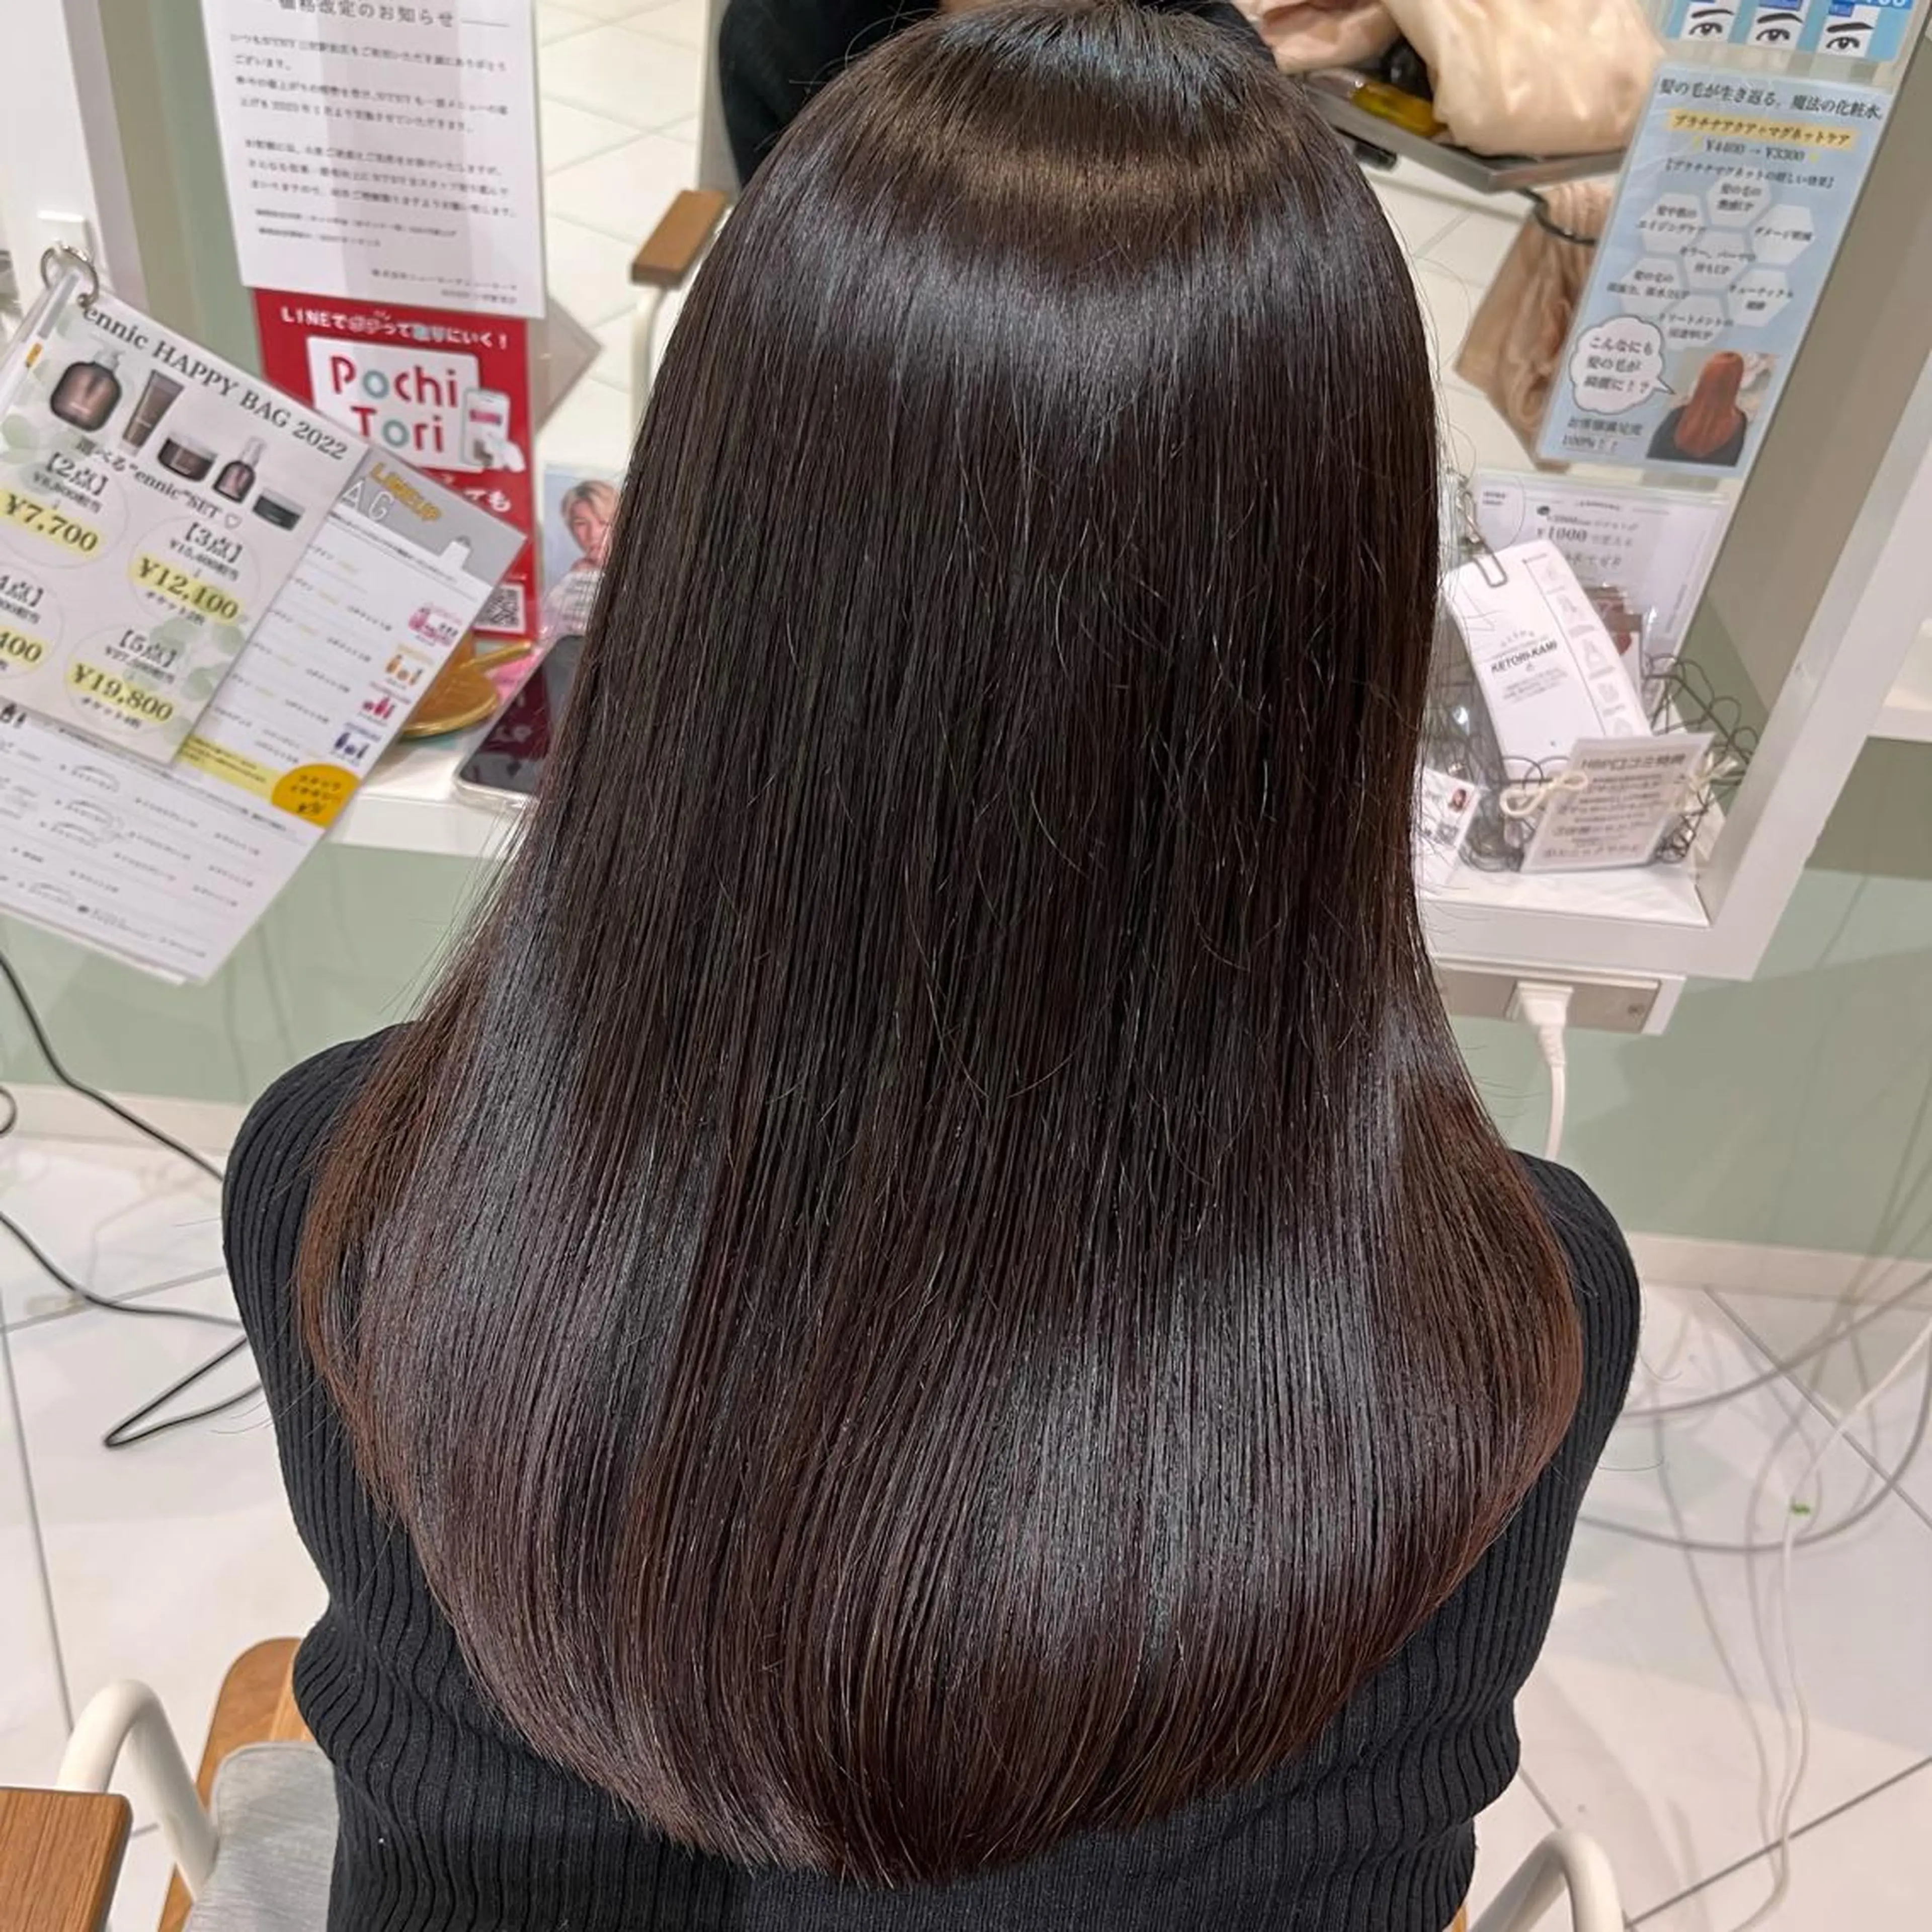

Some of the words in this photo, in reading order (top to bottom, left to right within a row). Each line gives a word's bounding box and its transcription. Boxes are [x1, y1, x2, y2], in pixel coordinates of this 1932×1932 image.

[83, 306, 148, 350] ennic
[151, 340, 241, 397] HAPPY
[240, 389, 290, 428] BAG
[292, 420, 349, 461] 2022
[330, 355, 459, 409] Pochi
[350, 406, 443, 454] Tori
